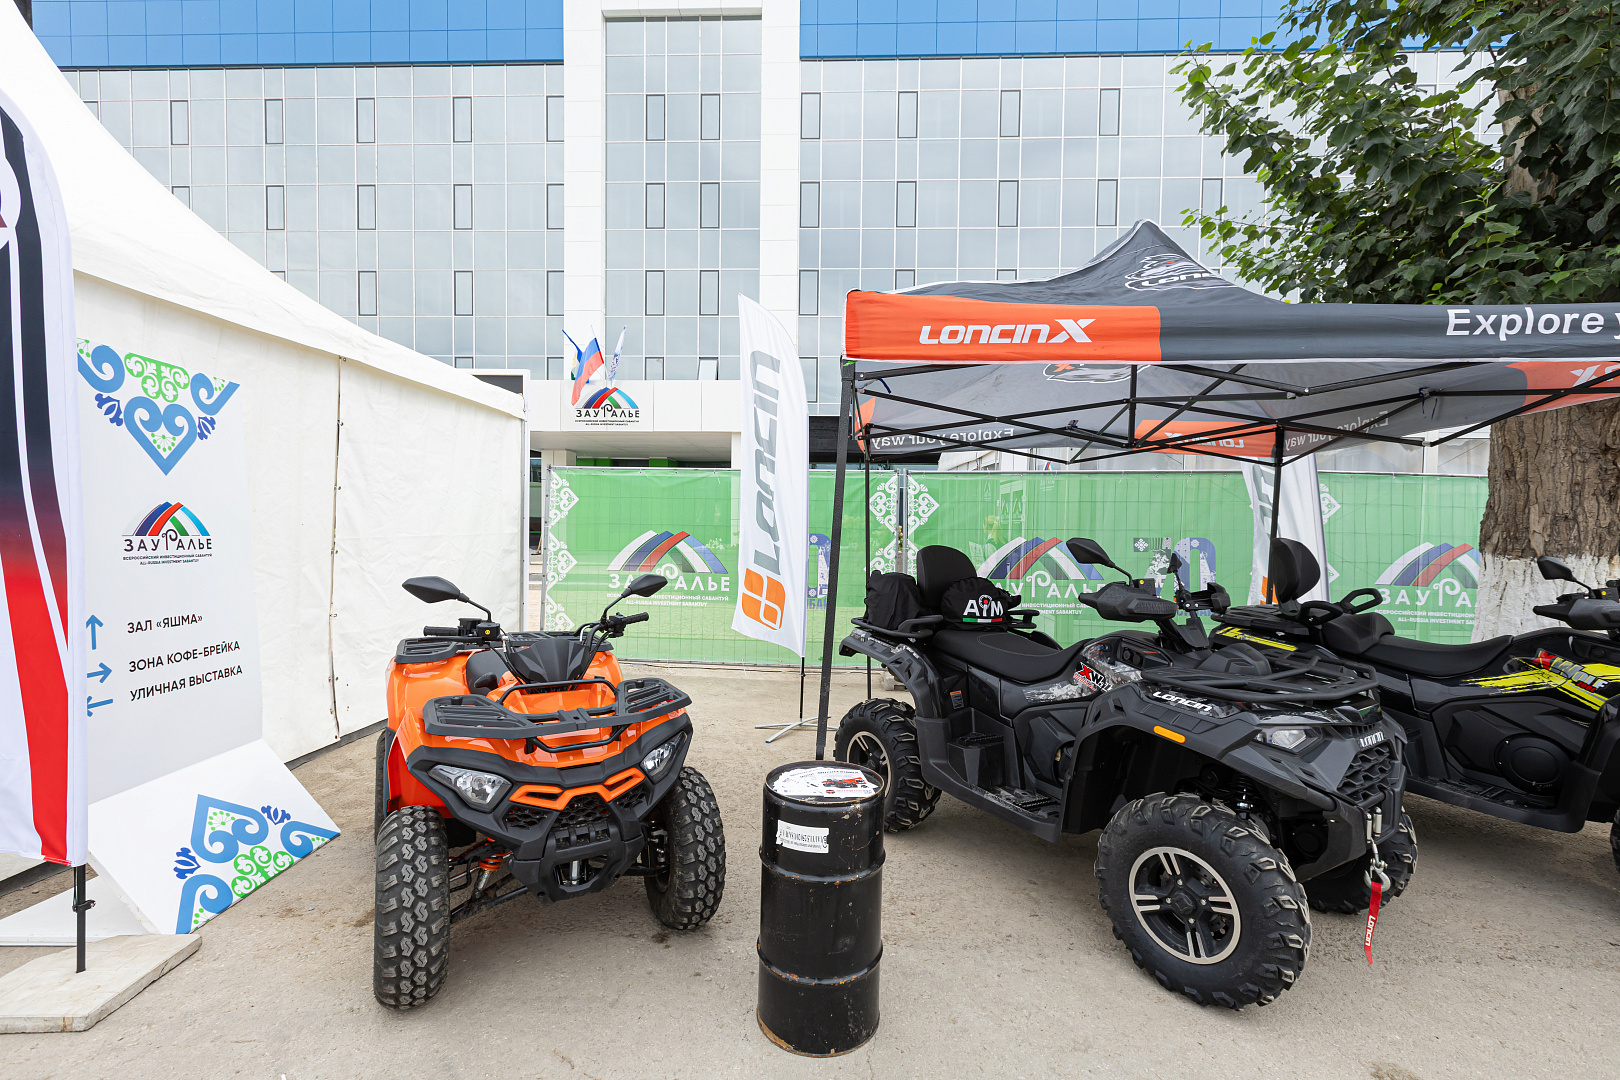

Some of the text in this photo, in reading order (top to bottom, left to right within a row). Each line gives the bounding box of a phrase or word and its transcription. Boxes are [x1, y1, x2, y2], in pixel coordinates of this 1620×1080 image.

[1446, 306, 1605, 341] Explore
[576, 404, 640, 418] ЗАУРАЛЬЕ
[123, 528, 212, 552] ЗАУРАЛЬЕ
[608, 563, 730, 592] ЗАРАЛЬЕ
[127, 613, 203, 634] ЗАЛ «ЯШМА»
[128, 640, 241, 673] ЗОНА КОФЕ-БРЕЙКА
[130, 664, 243, 702] УЛИЧНАЯ ВЫСТАВКА
